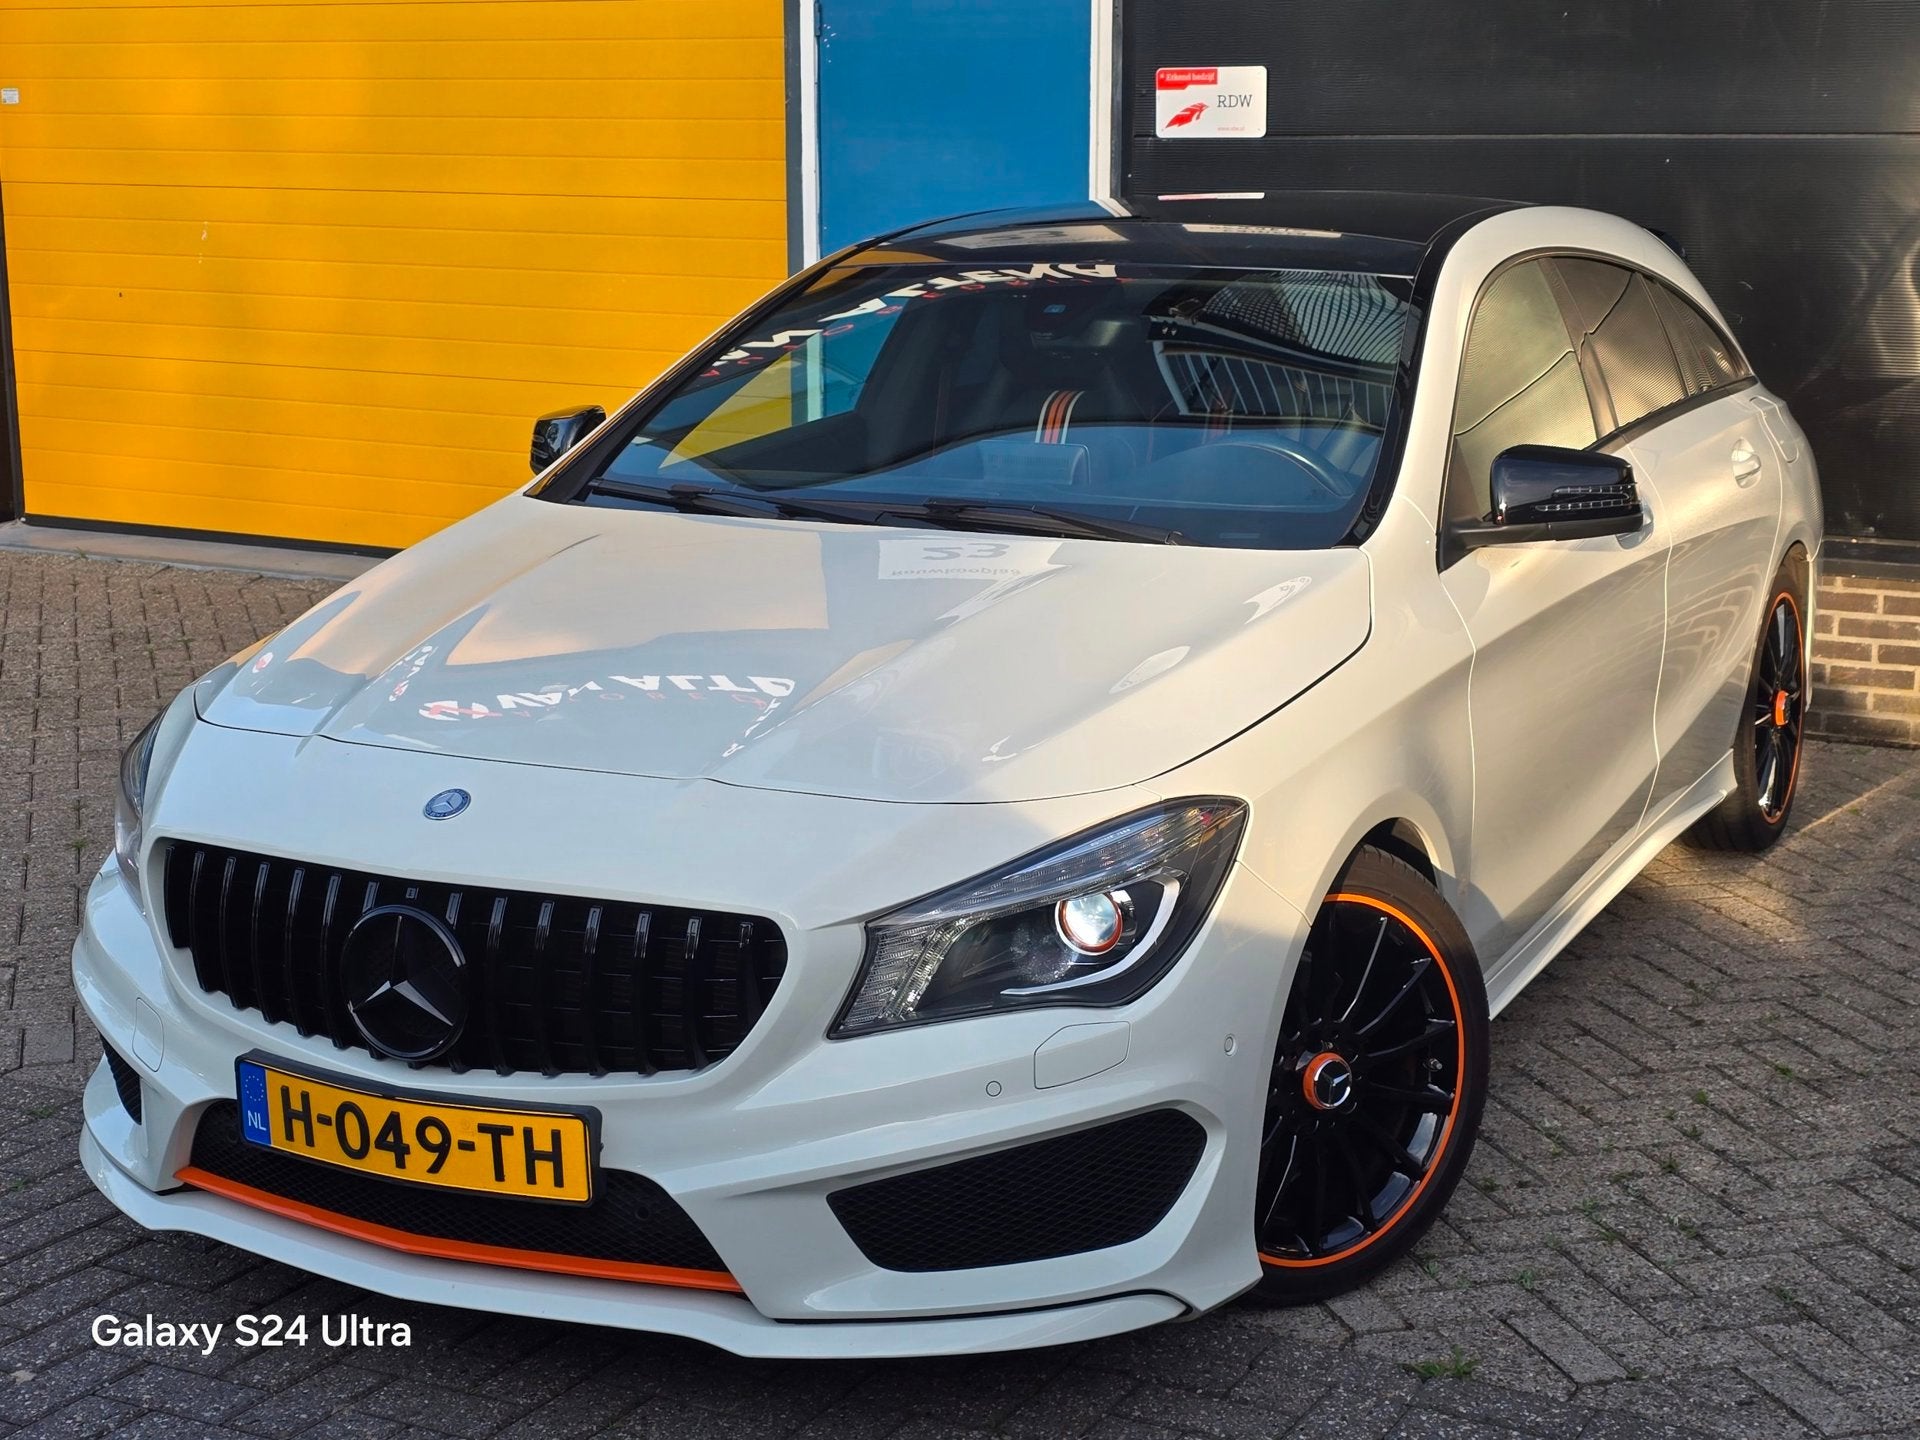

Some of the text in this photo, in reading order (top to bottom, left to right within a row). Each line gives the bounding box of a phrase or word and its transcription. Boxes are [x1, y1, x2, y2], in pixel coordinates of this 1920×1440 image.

[1217, 94, 1252, 108] RDW
[247, 1109, 267, 1131] NL
[280, 1085, 564, 1188] H-049-TH
